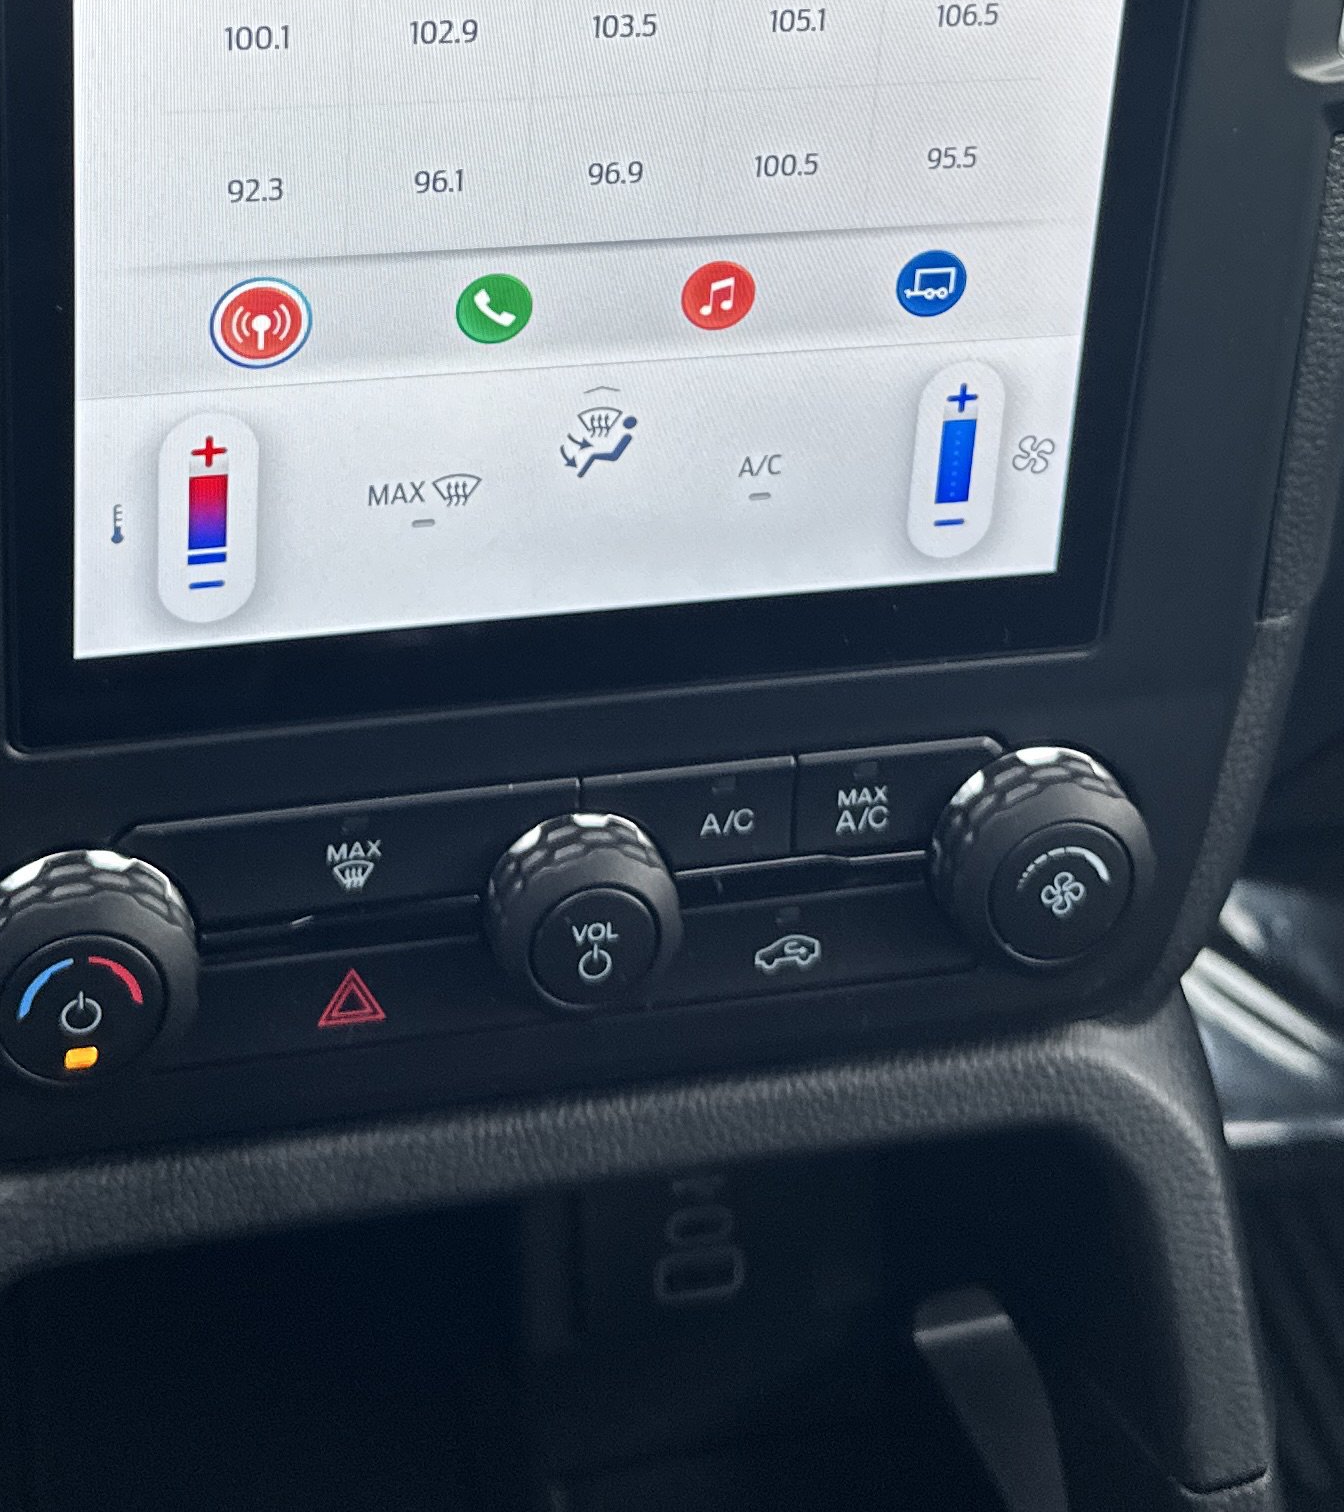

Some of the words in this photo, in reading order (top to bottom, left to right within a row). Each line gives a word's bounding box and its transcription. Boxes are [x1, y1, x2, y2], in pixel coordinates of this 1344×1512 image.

[591, 12, 658, 40] 103.5
[768, 6, 829, 35] 105.1
[936, 1, 1000, 29] 106.5
[223, 23, 292, 53] 100.1
[408, 17, 479, 46] 102.9
[753, 151, 820, 179] 100.5
[926, 144, 979, 171] 95.5
[413, 167, 466, 196] 96.1
[587, 159, 645, 187] 96.9
[226, 176, 285, 205] 92.3
[737, 453, 783, 478] A/C
[367, 480, 425, 507] MAX
[837, 785, 888, 808] MAX
[700, 807, 755, 837] A/C
[835, 805, 890, 834] A/C
[326, 839, 382, 864] MAX
[572, 921, 619, 944] VOL
